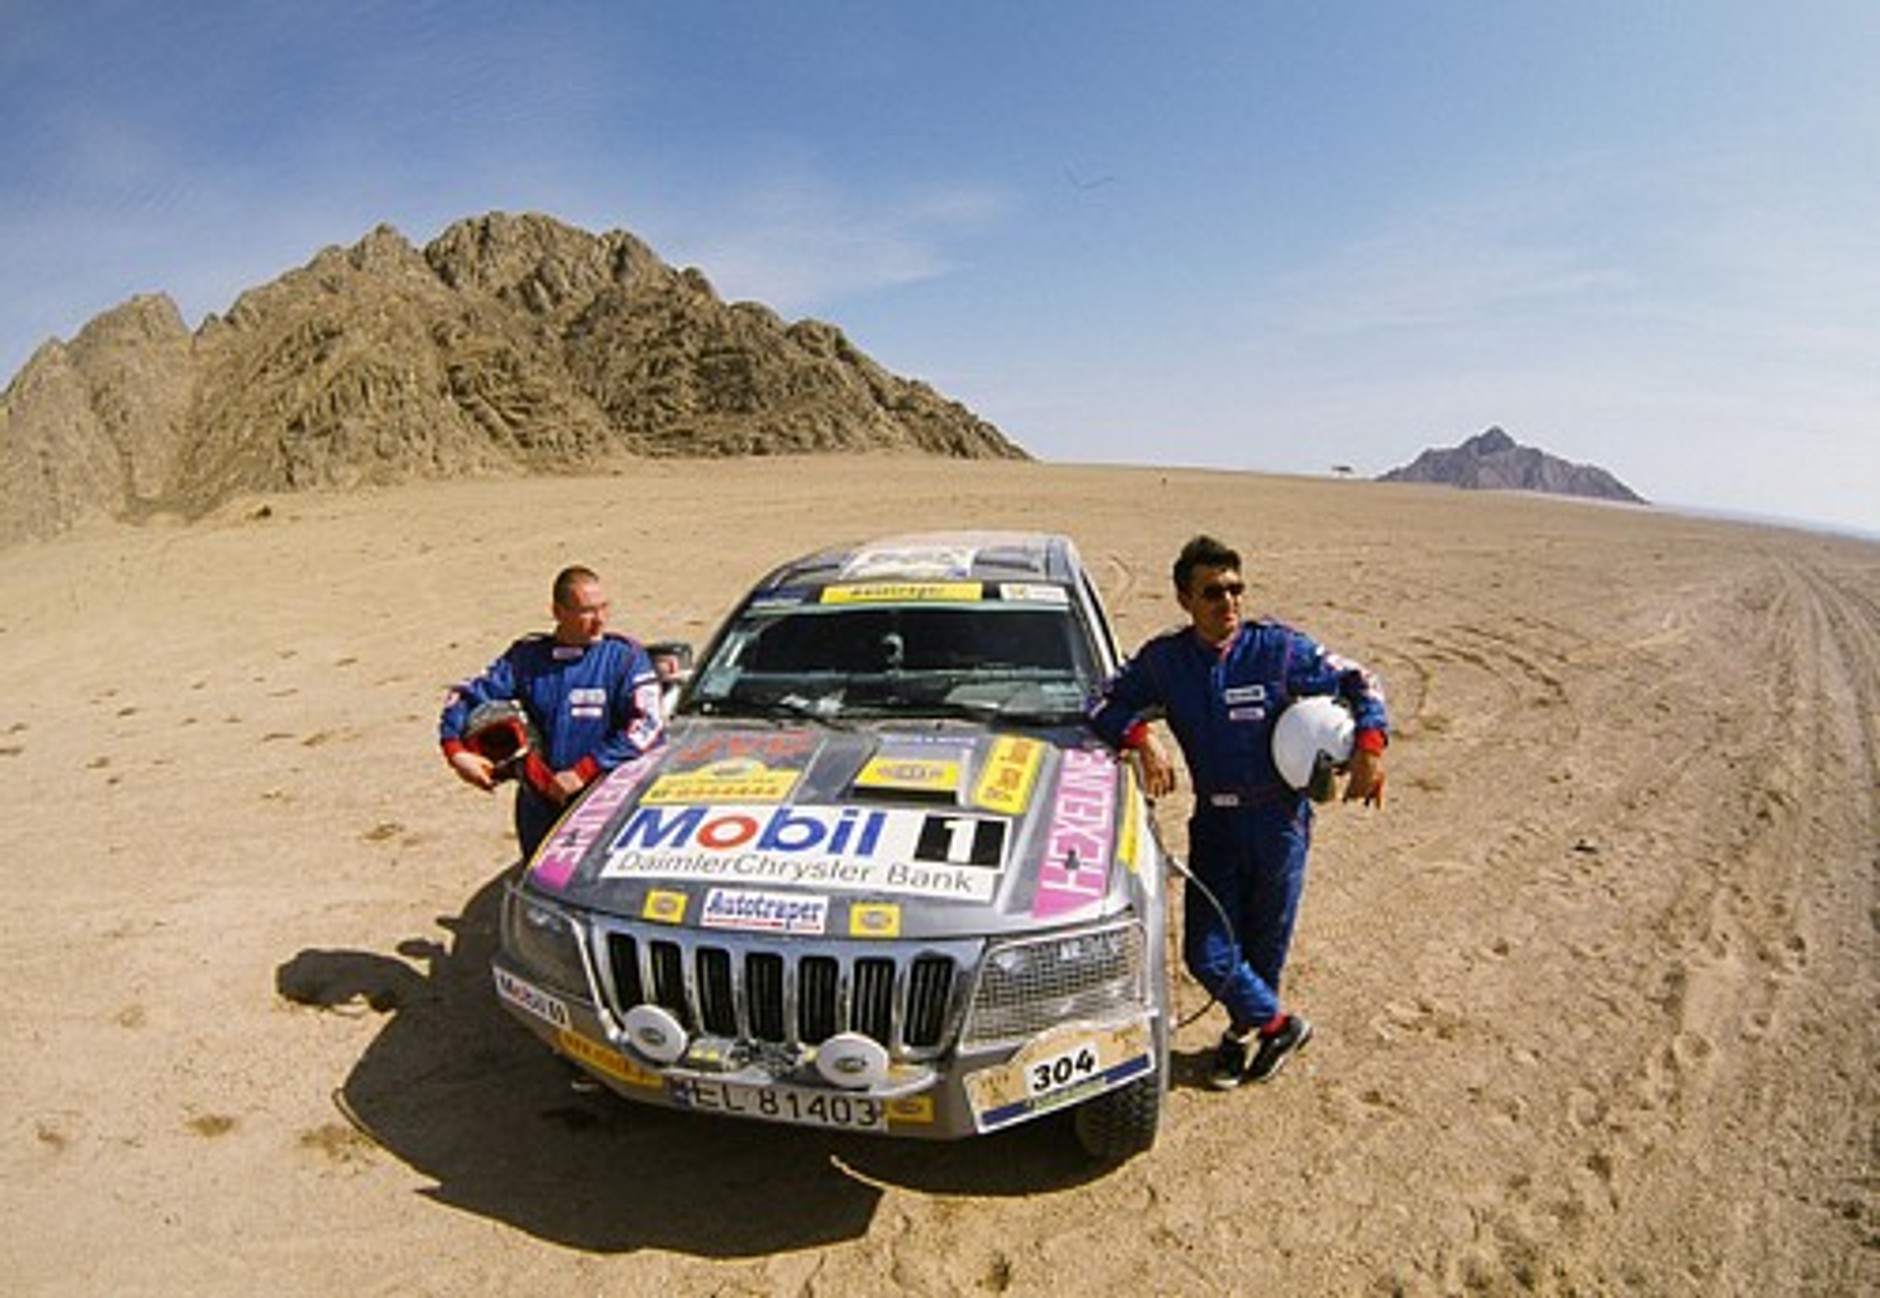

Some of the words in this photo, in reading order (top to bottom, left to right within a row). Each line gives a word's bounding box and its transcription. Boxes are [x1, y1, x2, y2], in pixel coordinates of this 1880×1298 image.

[614, 806, 887, 857] Mobil
[617, 852, 875, 882] DaimlerChrysler
[886, 864, 974, 892] Bank
[1033, 1048, 1095, 1092] 304
[694, 1078, 746, 1112] EL
[757, 1089, 879, 1127] 81403
